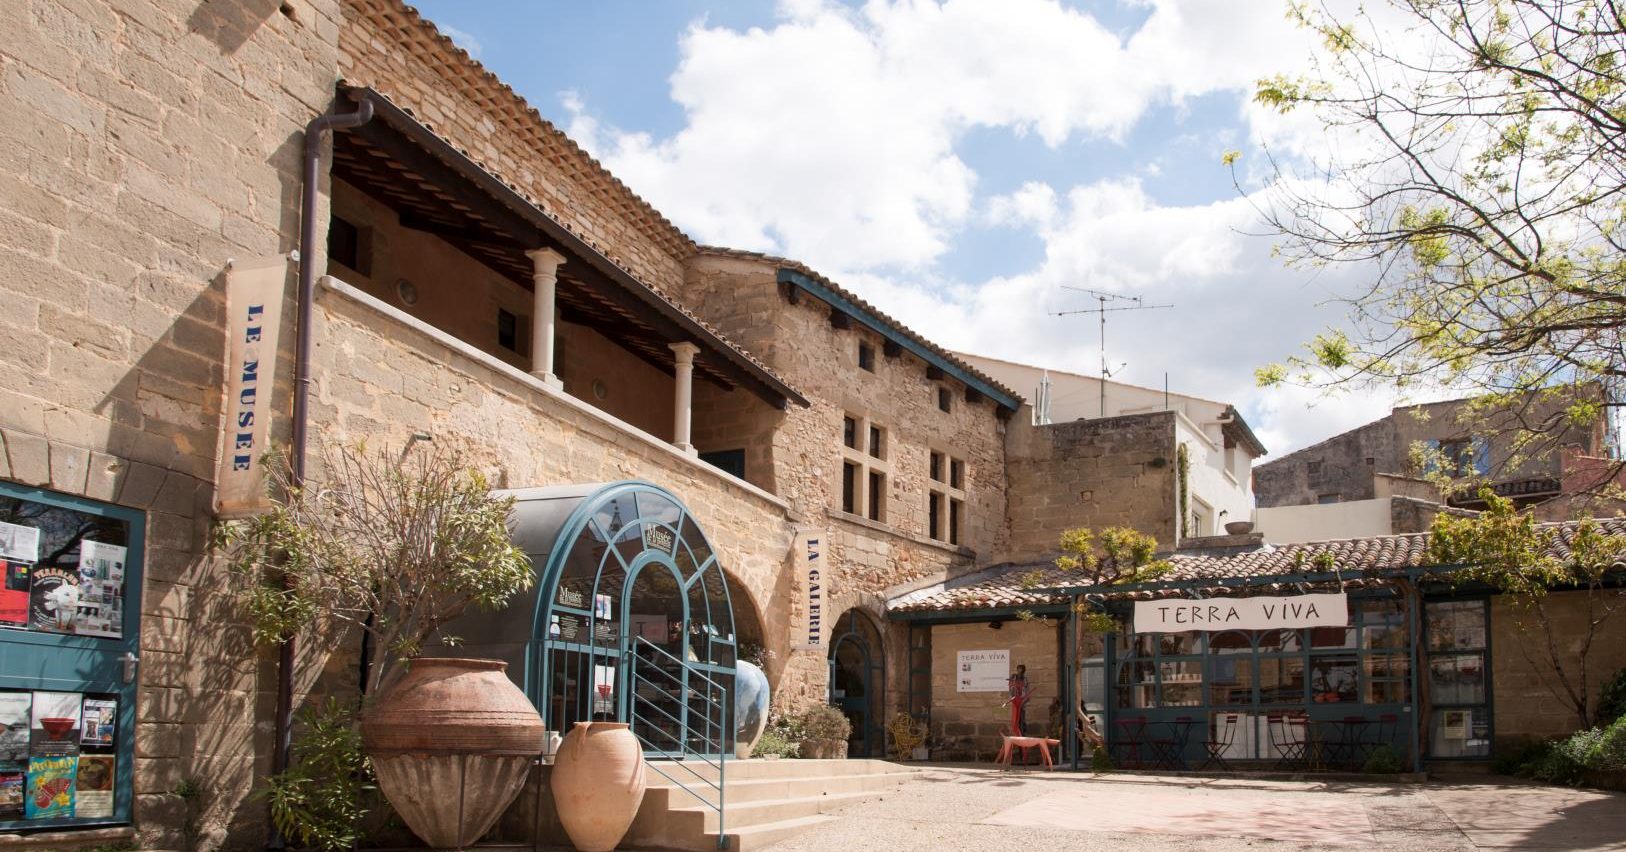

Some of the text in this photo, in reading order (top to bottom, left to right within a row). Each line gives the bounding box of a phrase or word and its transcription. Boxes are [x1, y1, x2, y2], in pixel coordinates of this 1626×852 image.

[246, 304, 264, 343] LE
[807, 539, 820, 645] LA GALERIE
[1157, 605, 1240, 624] TERRA
